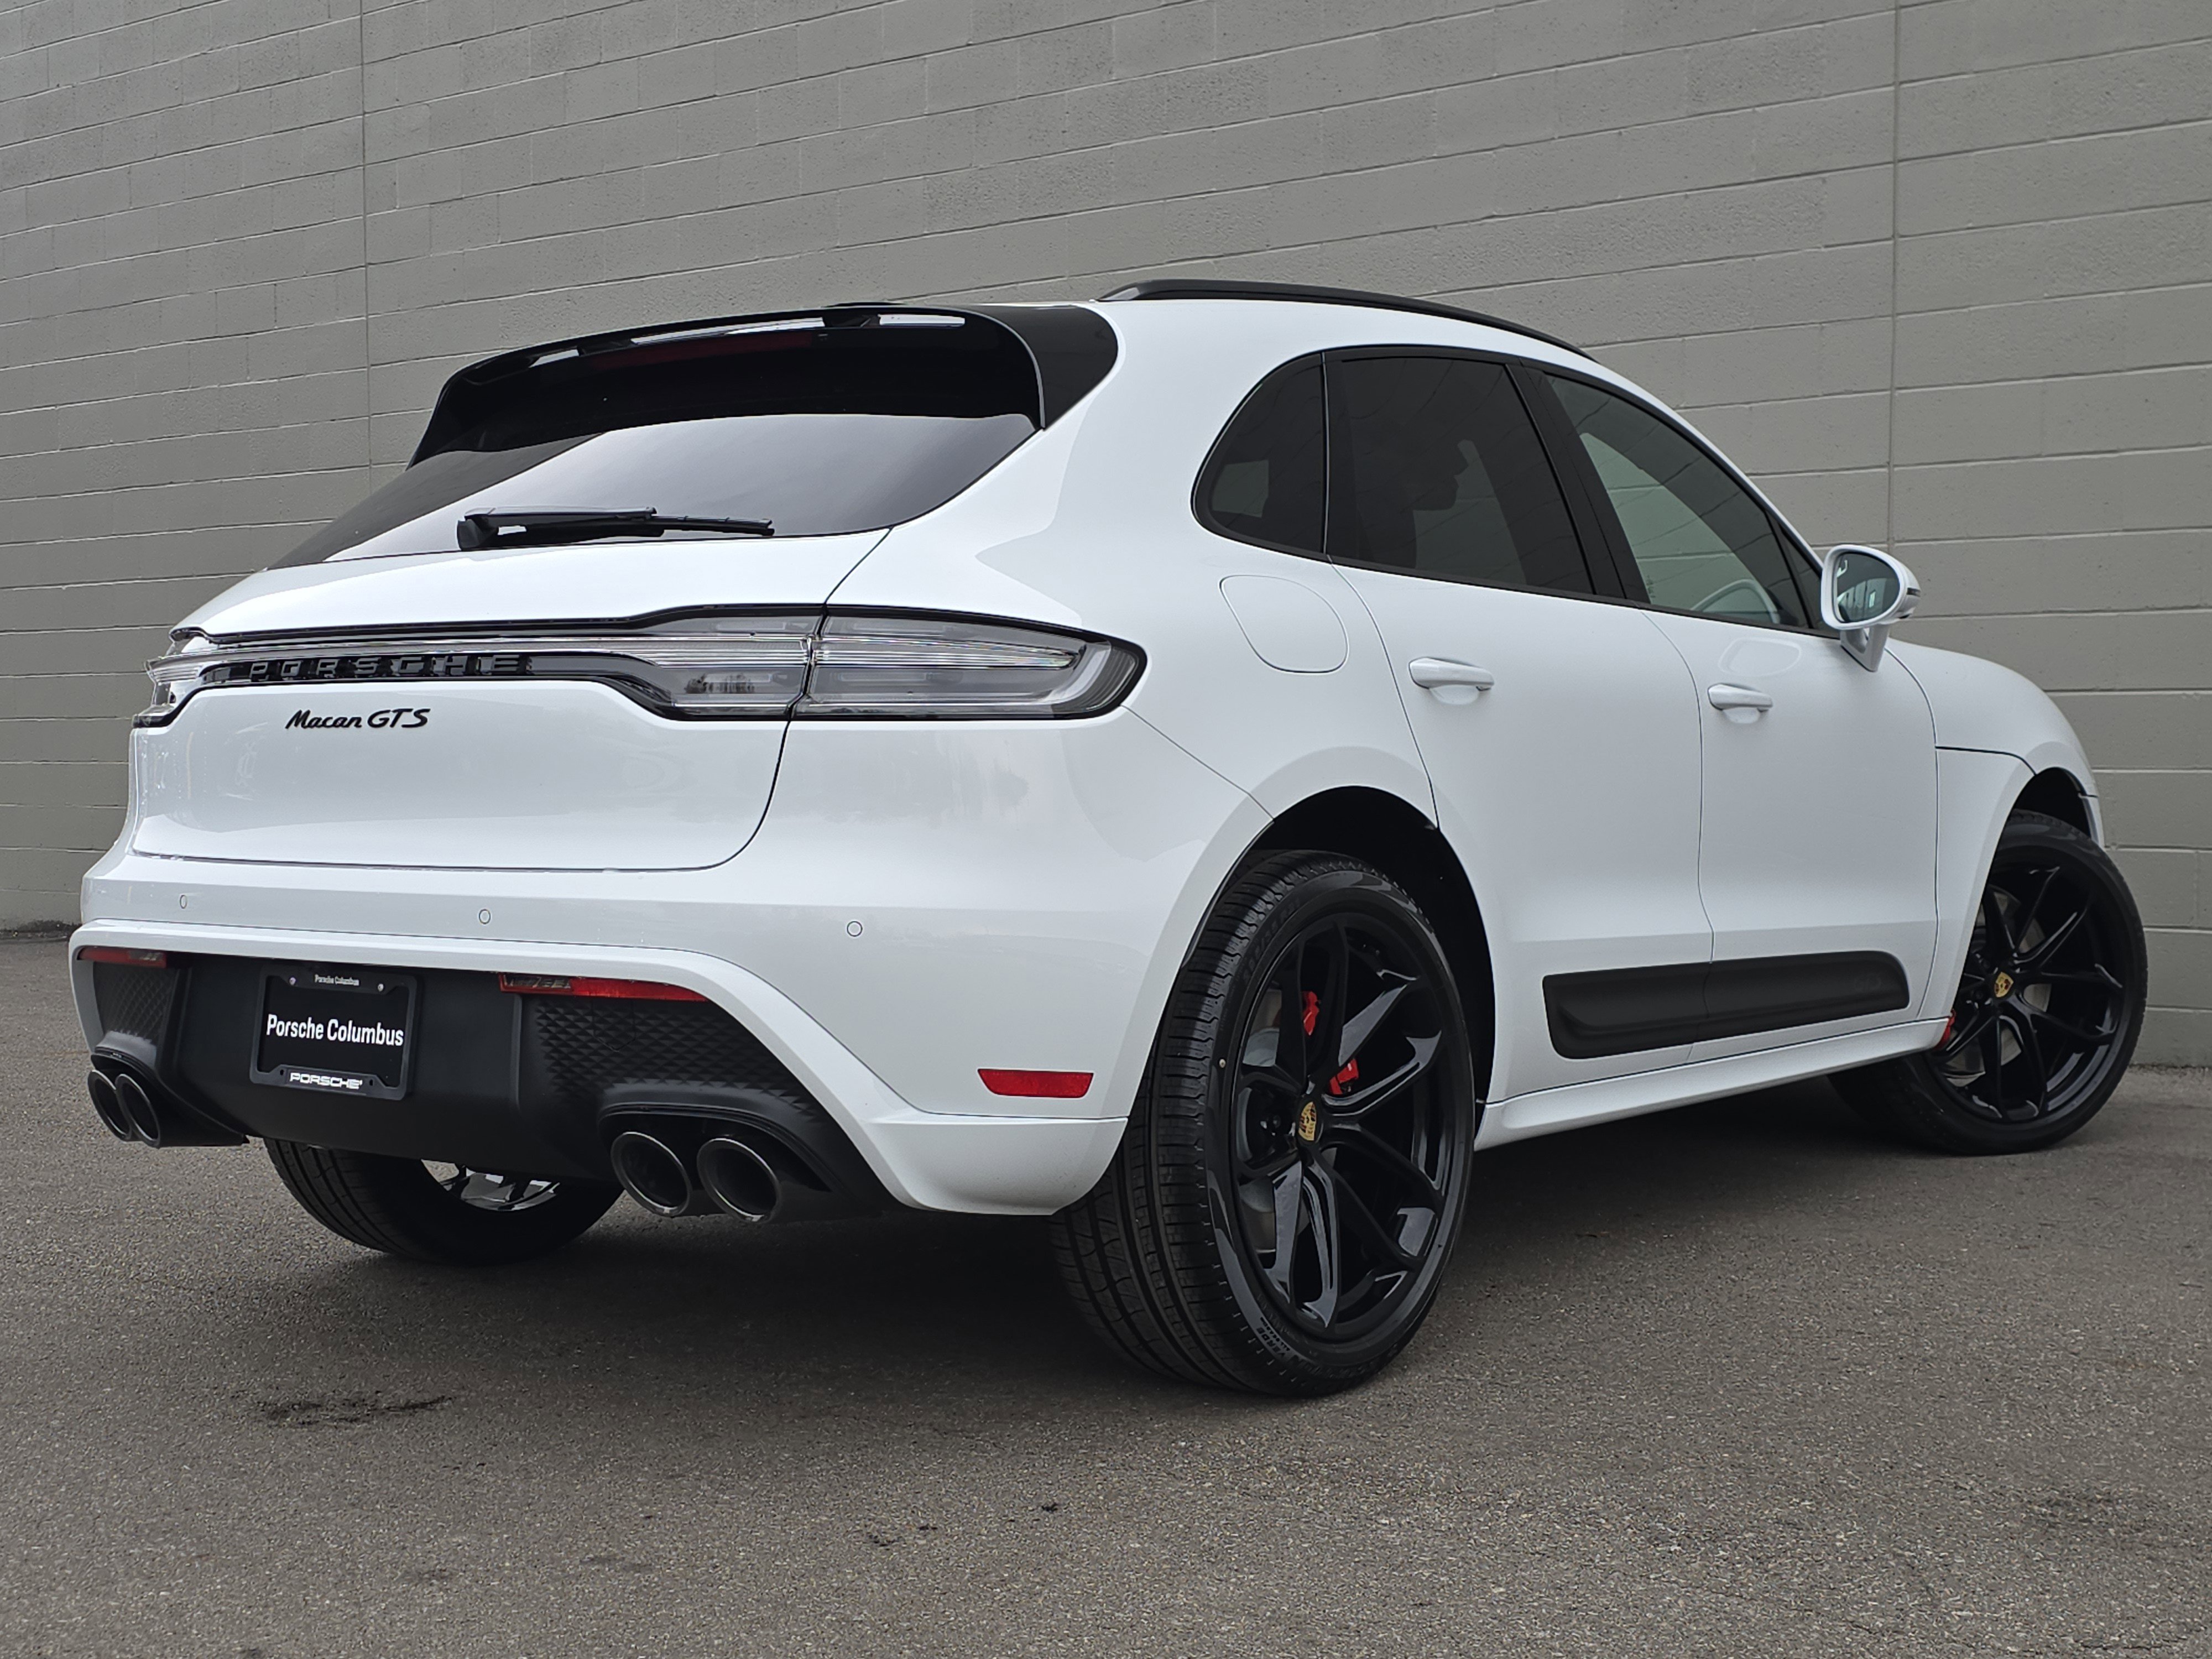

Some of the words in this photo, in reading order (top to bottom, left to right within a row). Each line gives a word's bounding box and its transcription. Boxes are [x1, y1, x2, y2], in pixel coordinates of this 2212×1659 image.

[250, 654, 521, 681] PORSCHE
[285, 709, 362, 729] Macan
[368, 708, 430, 728] GTS
[267, 1014, 324, 1040] Porsche
[327, 1019, 404, 1046] Columbus
[290, 1072, 360, 1089] PORSCHE
